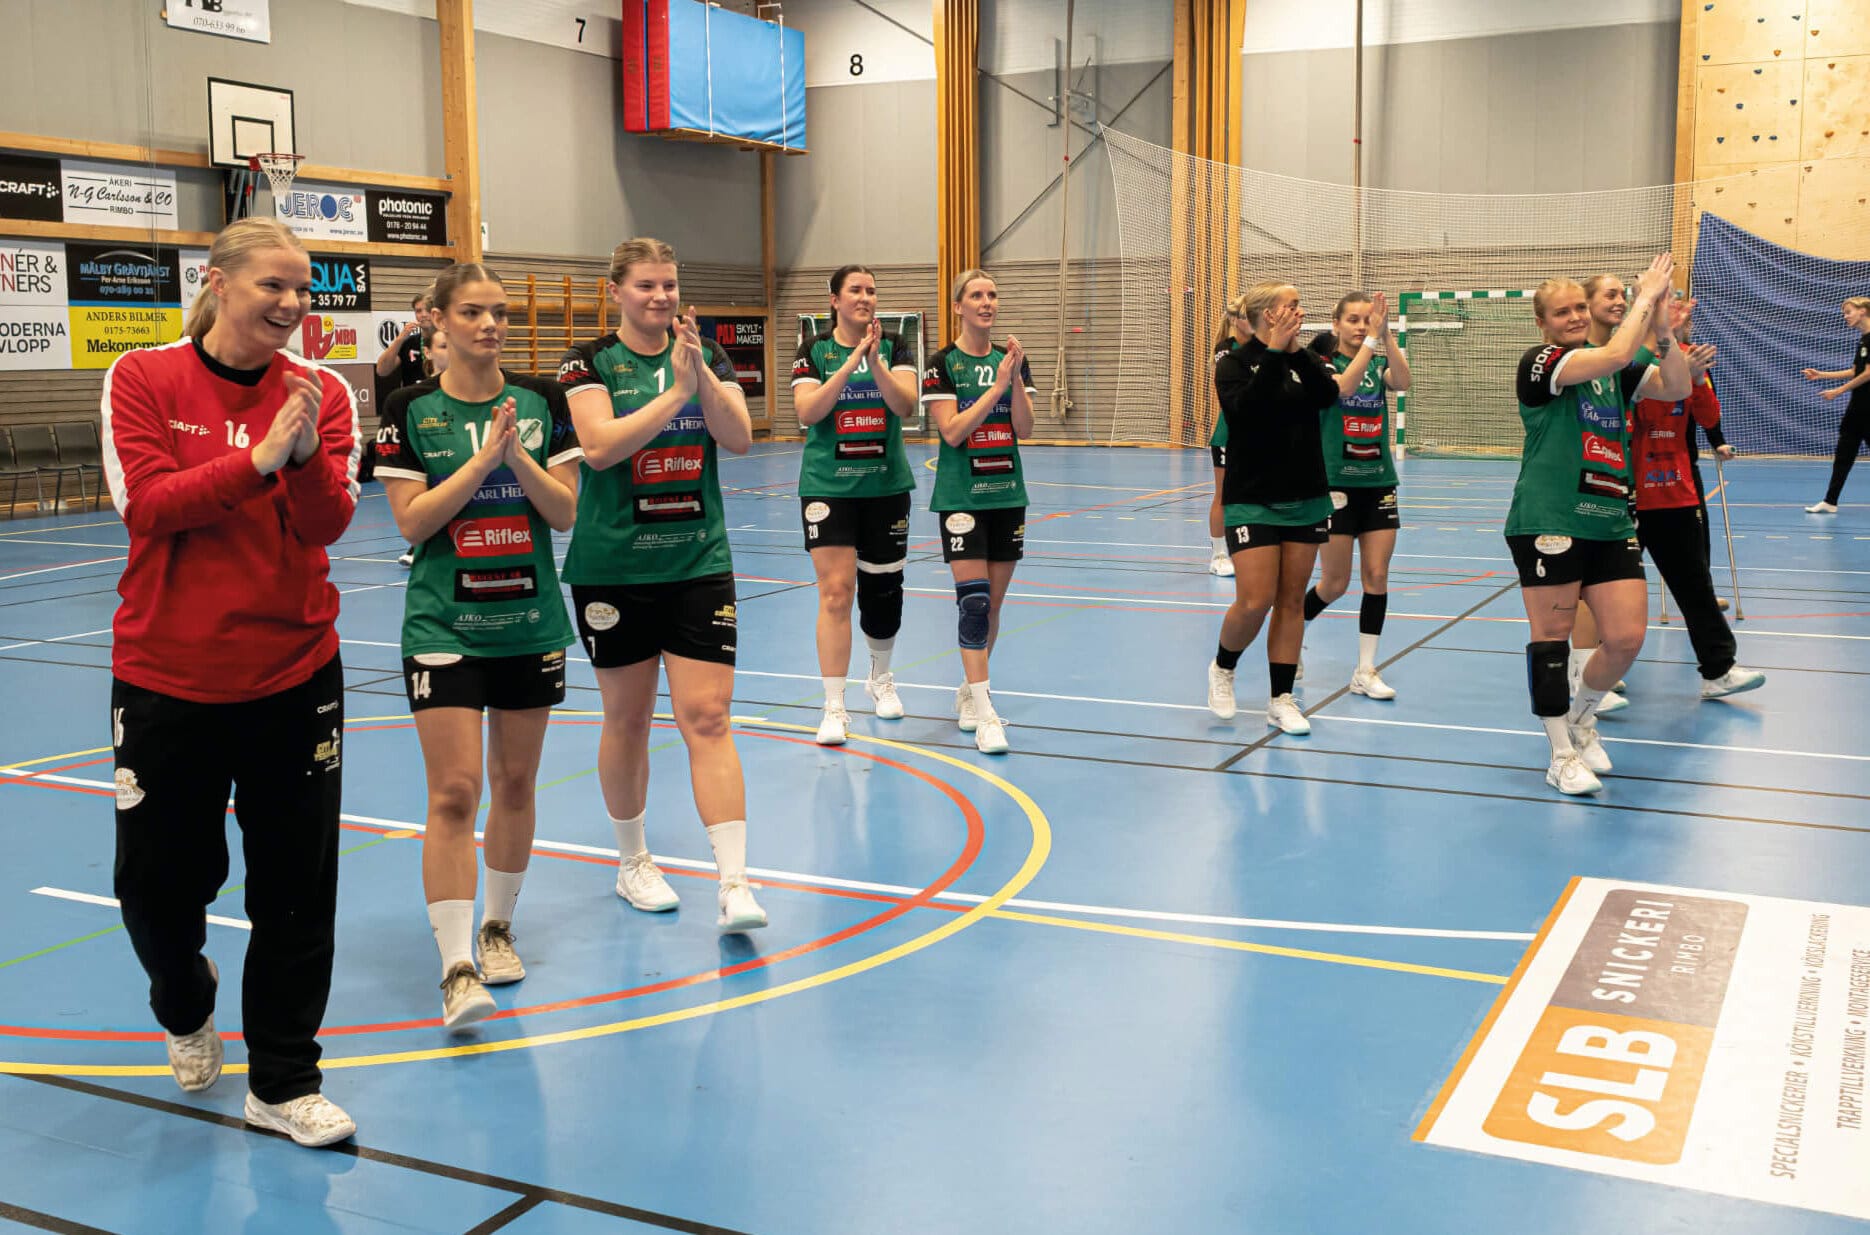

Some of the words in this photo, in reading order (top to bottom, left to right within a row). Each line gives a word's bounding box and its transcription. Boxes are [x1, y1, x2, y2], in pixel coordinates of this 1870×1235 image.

[575, 18, 586, 43] 7
[849, 54, 863, 76] 8
[0, 181, 46, 197] CRAFT
[109, 177, 132, 187] ÅKERI
[96, 186, 141, 204] Carlsson
[144, 190, 153, 204] &
[109, 206, 134, 215] RIMBO
[280, 191, 354, 222] JEROC
[378, 196, 433, 215] photonic
[44, 255, 58, 274] &
[80, 261, 112, 275] MÅLBY
[355, 263, 366, 293] VVS
[318, 294, 331, 306] 35
[332, 294, 344, 307] 79
[345, 294, 357, 307] 77
[86, 311, 127, 322] ANDERS
[129, 312, 168, 322] BILMEK
[104, 326, 150, 335] 0175-73663
[974, 365, 997, 387] 22
[855, 416, 885, 427] Riflex
[225, 419, 250, 449] 16
[664, 456, 703, 472] Riflex
[473, 488, 500, 500] ARL
[484, 527, 532, 546] Riflex
[808, 524, 819, 540] 20
[1236, 525, 1250, 544] 13
[950, 536, 965, 552] 22
[1536, 558, 1547, 578] 6
[411, 671, 432, 701] 14
[1591, 899, 1675, 1004] SNICKERI
[1669, 933, 1706, 975] RIMBO
[1788, 975, 1822, 1059] KÖKSTILLVERKNING
[1526, 1024, 1678, 1143] SLB
[1836, 1027, 1867, 1130] TRAPPTILLVERKNING
[1769, 1070, 1810, 1181] SPECIALSNICKERIER
